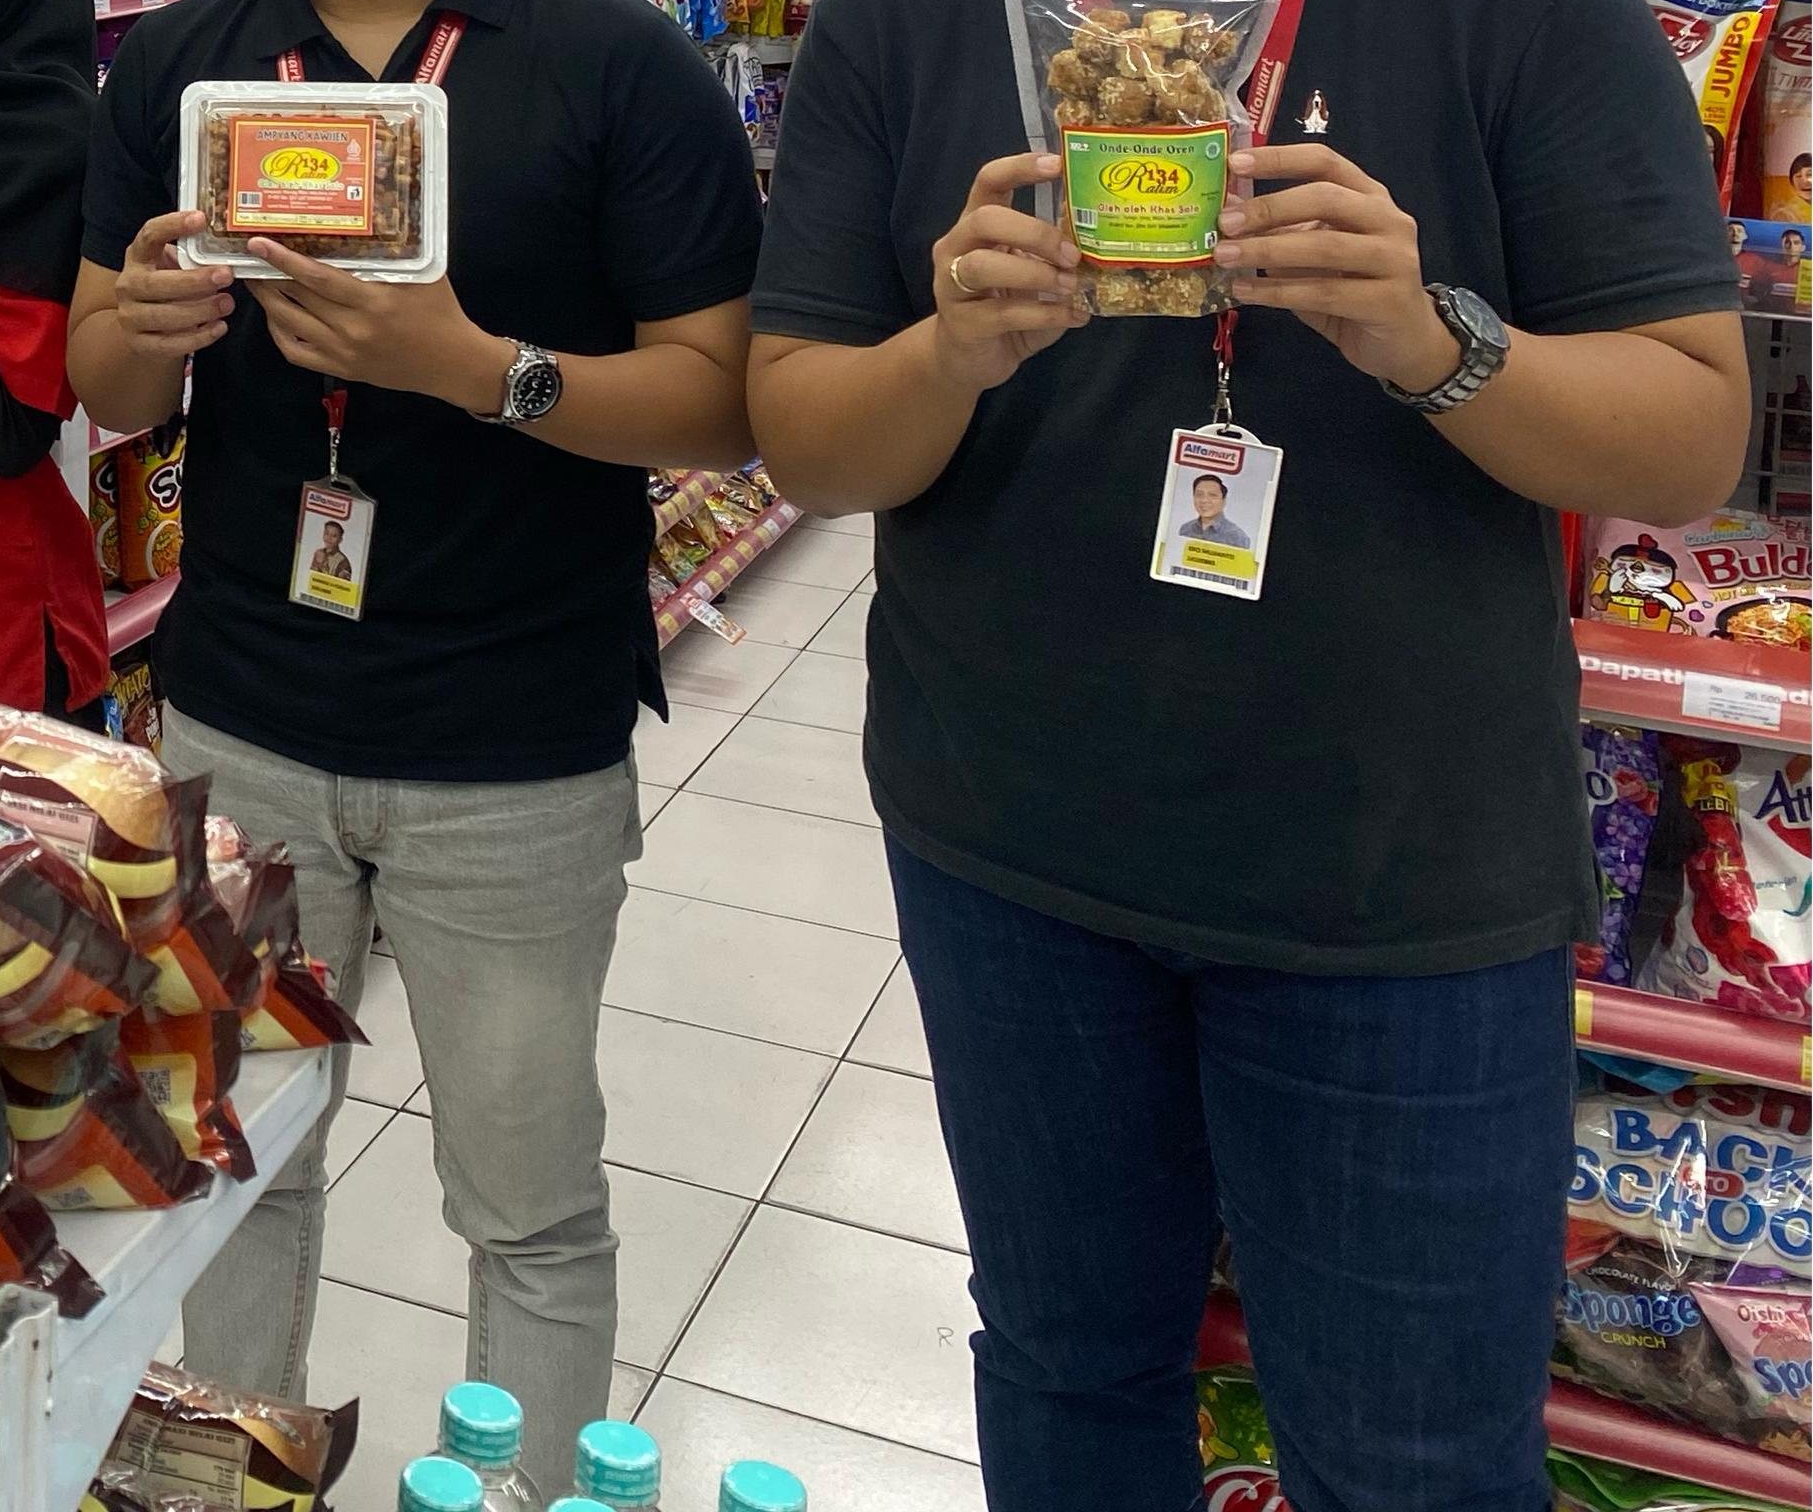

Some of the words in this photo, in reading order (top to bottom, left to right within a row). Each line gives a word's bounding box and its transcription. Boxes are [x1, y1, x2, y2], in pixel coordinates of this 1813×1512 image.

[1711, 15, 1752, 99] JUMBO
[1099, 143, 1164, 155] Onde-Onde
[302, 156, 329, 173] 134
[1147, 168, 1179, 185] 134
[1184, 443, 1237, 462] Alfamart
[1737, 1304, 1786, 1325] Oishi
[1600, 1331, 1667, 1350] CRUNCH
